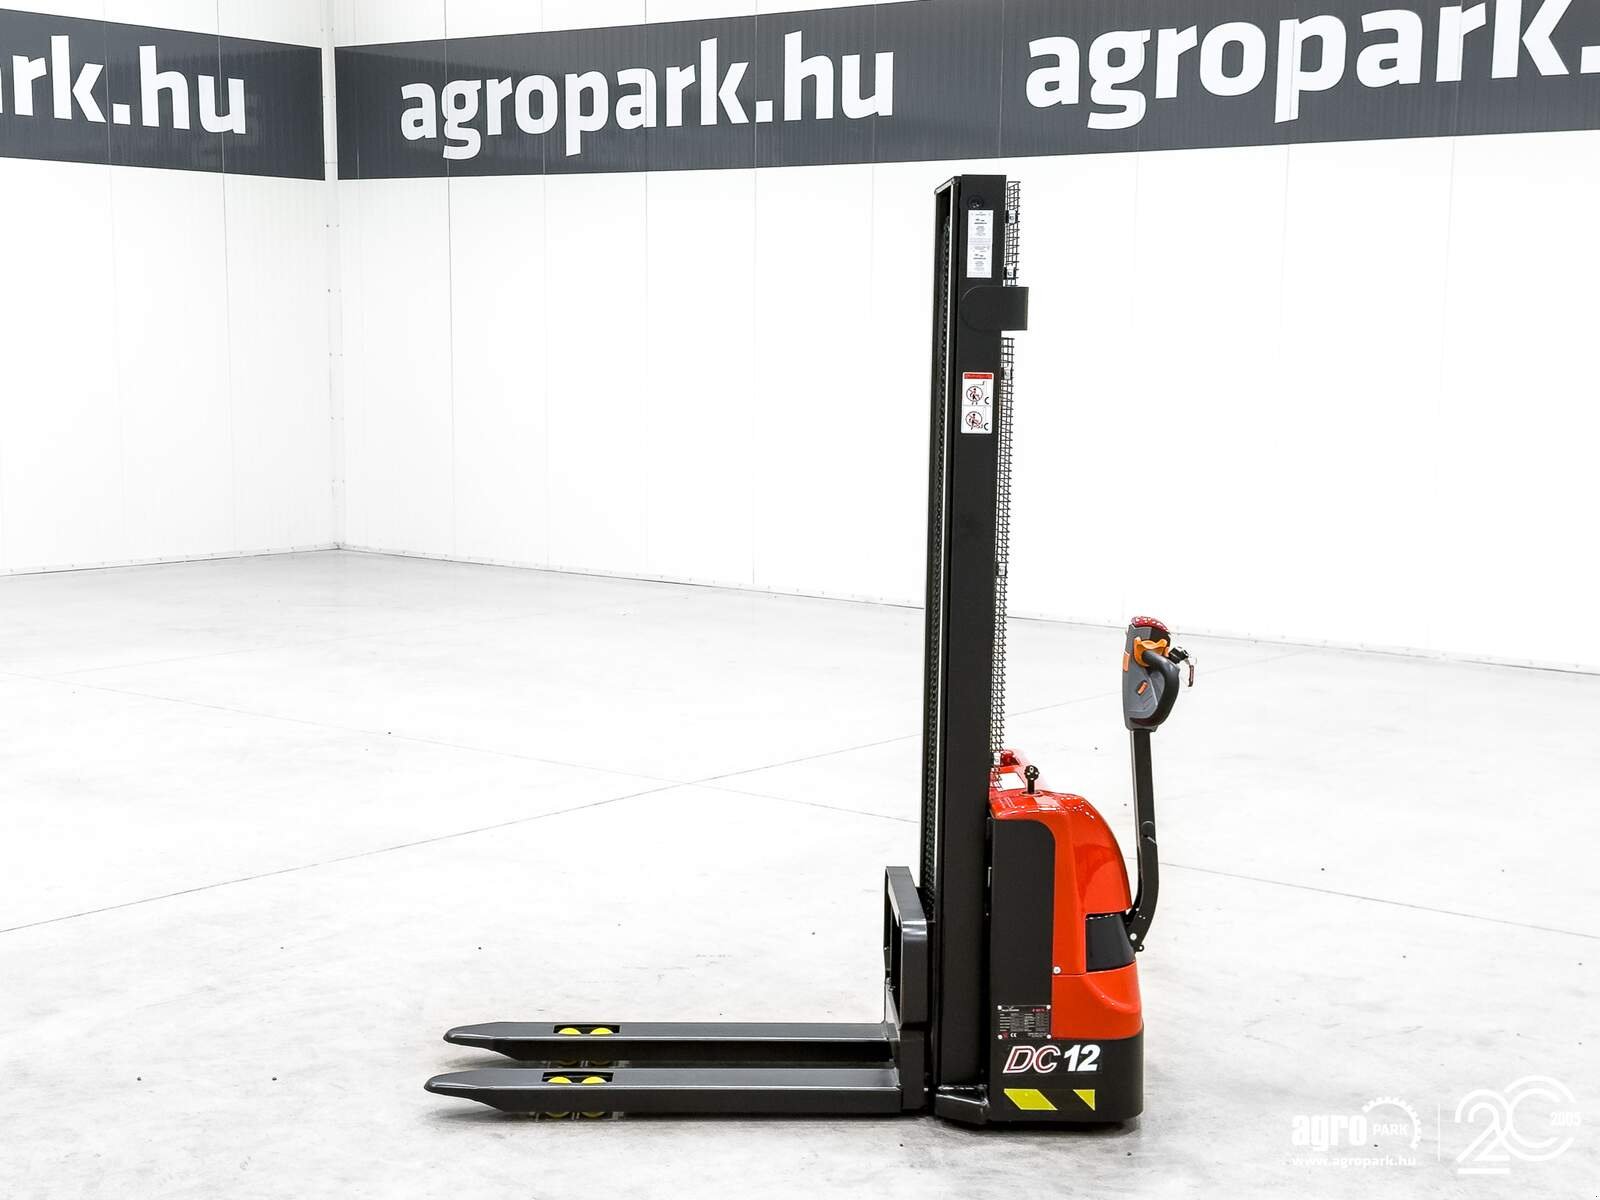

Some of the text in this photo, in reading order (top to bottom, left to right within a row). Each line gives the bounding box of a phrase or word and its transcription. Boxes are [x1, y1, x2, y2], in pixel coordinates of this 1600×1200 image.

[0, 35, 246, 134] rk.hu
[400, 30, 894, 160] agropark.hu
[1063, 1044, 1101, 1072] 12
